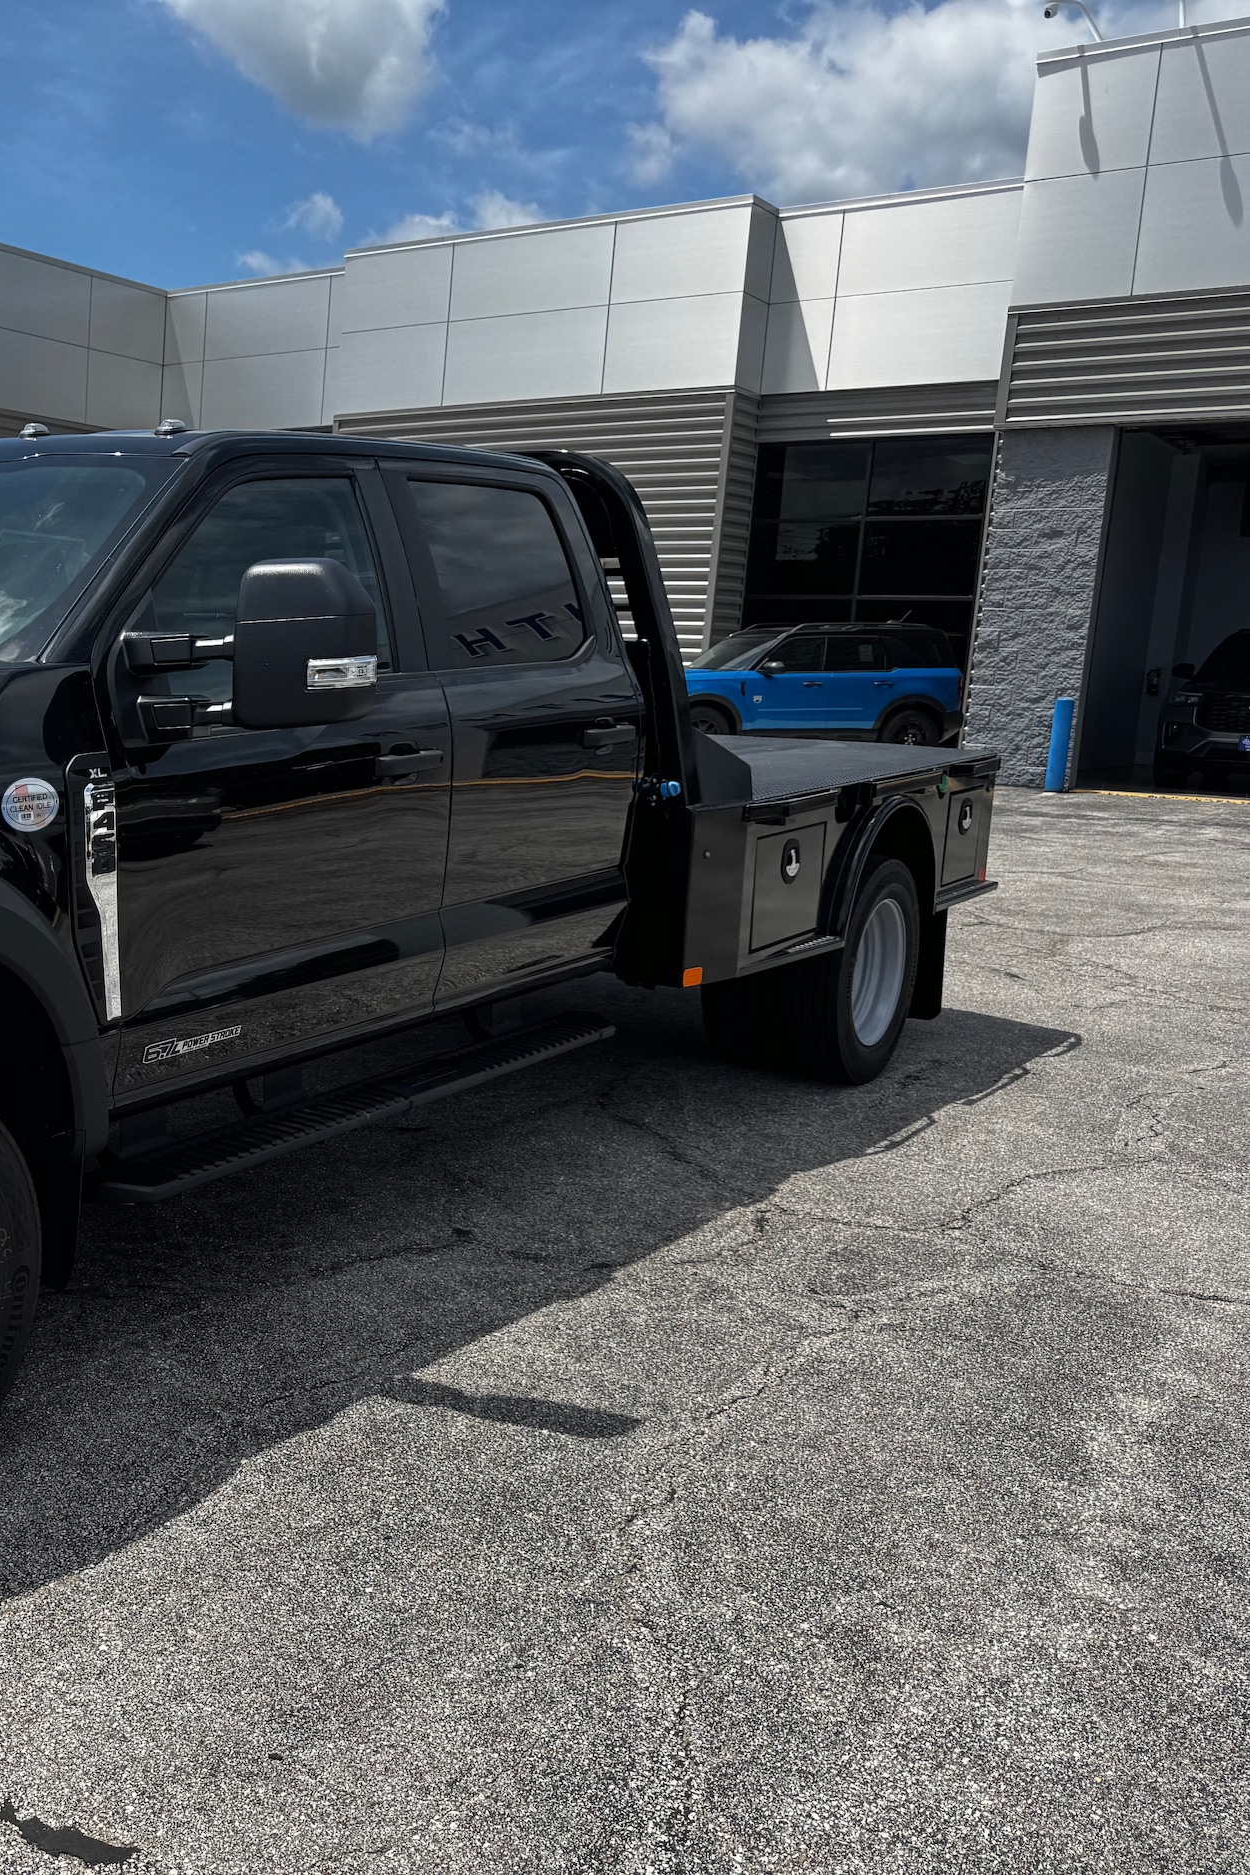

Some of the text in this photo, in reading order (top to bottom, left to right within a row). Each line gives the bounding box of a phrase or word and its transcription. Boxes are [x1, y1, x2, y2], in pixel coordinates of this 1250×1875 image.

[89, 768, 107, 778] XL
[12, 793, 48, 804] CERTIFIED
[10, 801, 52, 813] CLEAN IDLE
[182, 1035, 210, 1049] POWER
[210, 1027, 241, 1042] STROKE
